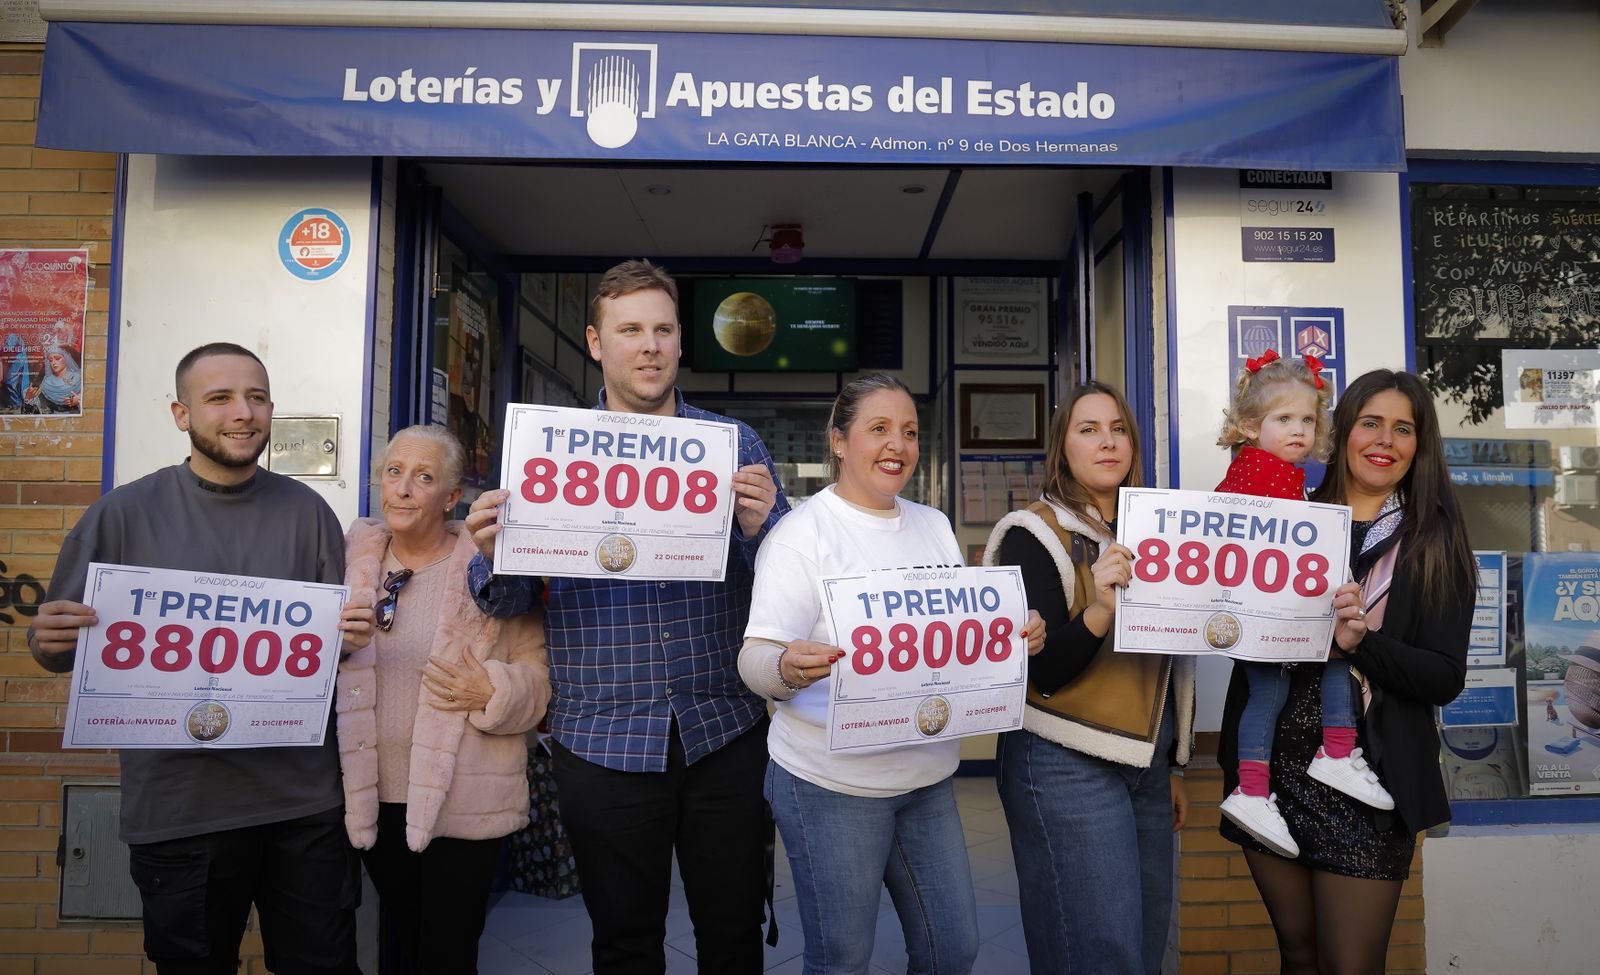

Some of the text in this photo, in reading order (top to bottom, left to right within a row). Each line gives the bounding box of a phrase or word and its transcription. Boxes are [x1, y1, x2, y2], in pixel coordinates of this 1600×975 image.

[343, 67, 562, 115] Loterías y
[665, 72, 1116, 120] Apuestas del Estado
[706, 131, 730, 146] LA
[733, 132, 781, 147] GATA
[785, 133, 857, 149] BLANCA
[871, 136, 933, 152] Admon.
[959, 138, 970, 152] 9
[974, 138, 994, 152] de
[999, 139, 1031, 153] Dos
[1036, 140, 1118, 154] Hermanas
[1247, 170, 1326, 184] CONECTADA
[301, 223, 331, 240] +18
[1254, 231, 1323, 241] 902 15 15 20
[1433, 235, 1443, 248] E
[1435, 266, 1476, 281] CON
[1489, 260, 1547, 276] AYUDA
[970, 305, 1031, 314] GRAN PREMIO
[1547, 371, 1575, 380] 11397
[596, 414, 663, 427] VENDIDO AQUÍ
[568, 429, 706, 464] PREMIO
[520, 457, 719, 514] 88008
[1207, 495, 1273, 509] VENDIDO AQUÍ
[1180, 510, 1318, 547] PREMIO
[512, 547, 544, 555] LOTERÍA
[1134, 538, 1329, 597] 88008
[193, 575, 266, 589] VENDIDO AQUÍ
[902, 572, 938, 581] VENDIDO
[939, 570, 958, 580] AQUÍ
[1555, 581, 1578, 596] ¿Y
[159, 590, 313, 627] PREMIO
[882, 586, 1001, 618] PREMIO
[1553, 595, 1600, 624] AQ
[101, 620, 323, 678] 88008
[851, 617, 1014, 675] 88008
[975, 705, 1007, 716] DICIEMBRE
[87, 716, 125, 725] LOTERÍA
[135, 718, 177, 726] NAVIDAD
[841, 719, 870, 730] LOTERÍA
[878, 717, 910, 727] NAVIDAD
[1558, 763, 1571, 771] LA
[1536, 770, 1572, 779] VENTA
